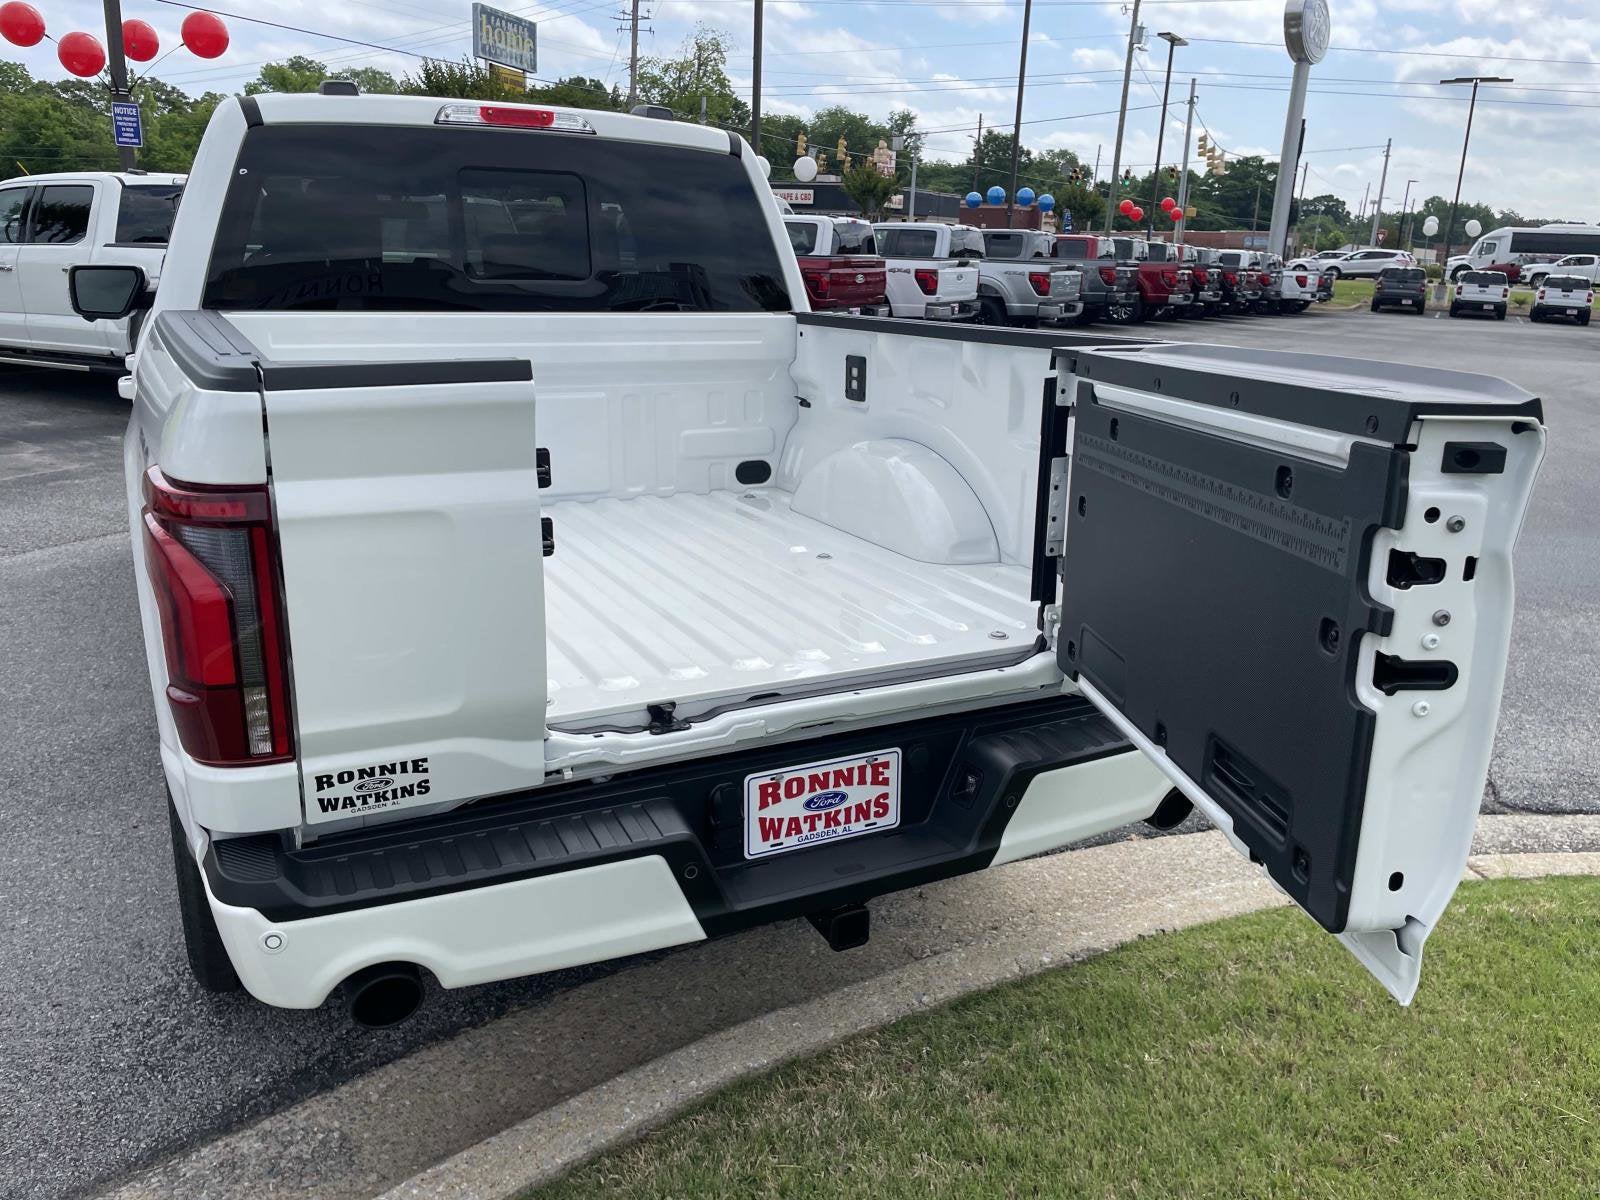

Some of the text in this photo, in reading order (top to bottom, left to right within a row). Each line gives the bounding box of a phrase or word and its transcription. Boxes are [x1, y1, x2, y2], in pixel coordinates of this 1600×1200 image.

[114, 106, 137, 116] NOTICE
[314, 757, 429, 793] RONNIE
[758, 760, 890, 811] RONNIE
[317, 778, 431, 813] WATKINS
[350, 802, 388, 814] GADSDEN
[810, 792, 842, 808] Ford
[758, 792, 890, 843] WATKINS
[797, 825, 853, 843] GADSDEN, AL
